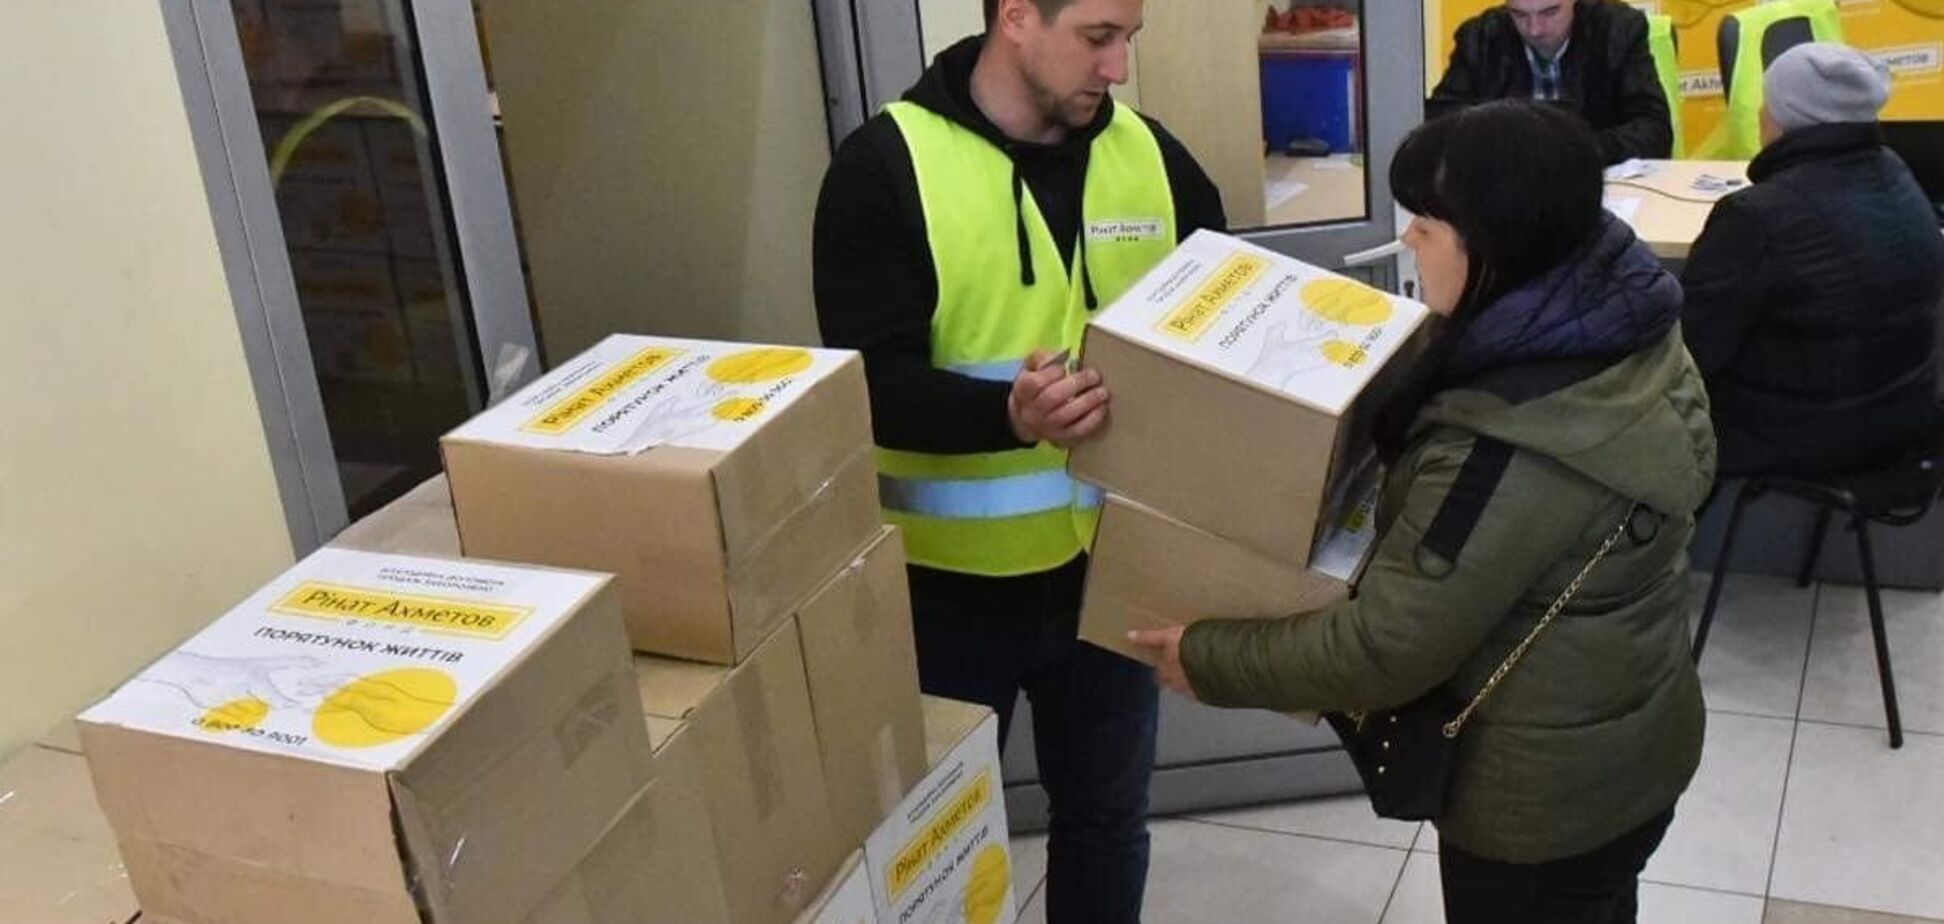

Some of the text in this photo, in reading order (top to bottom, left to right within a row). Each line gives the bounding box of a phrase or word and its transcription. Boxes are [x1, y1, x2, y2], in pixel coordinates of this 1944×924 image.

[303, 588, 496, 628] Рінат Ахметов
[254, 626, 464, 664] ПОРЯТУНОК ЖИТТІВ
